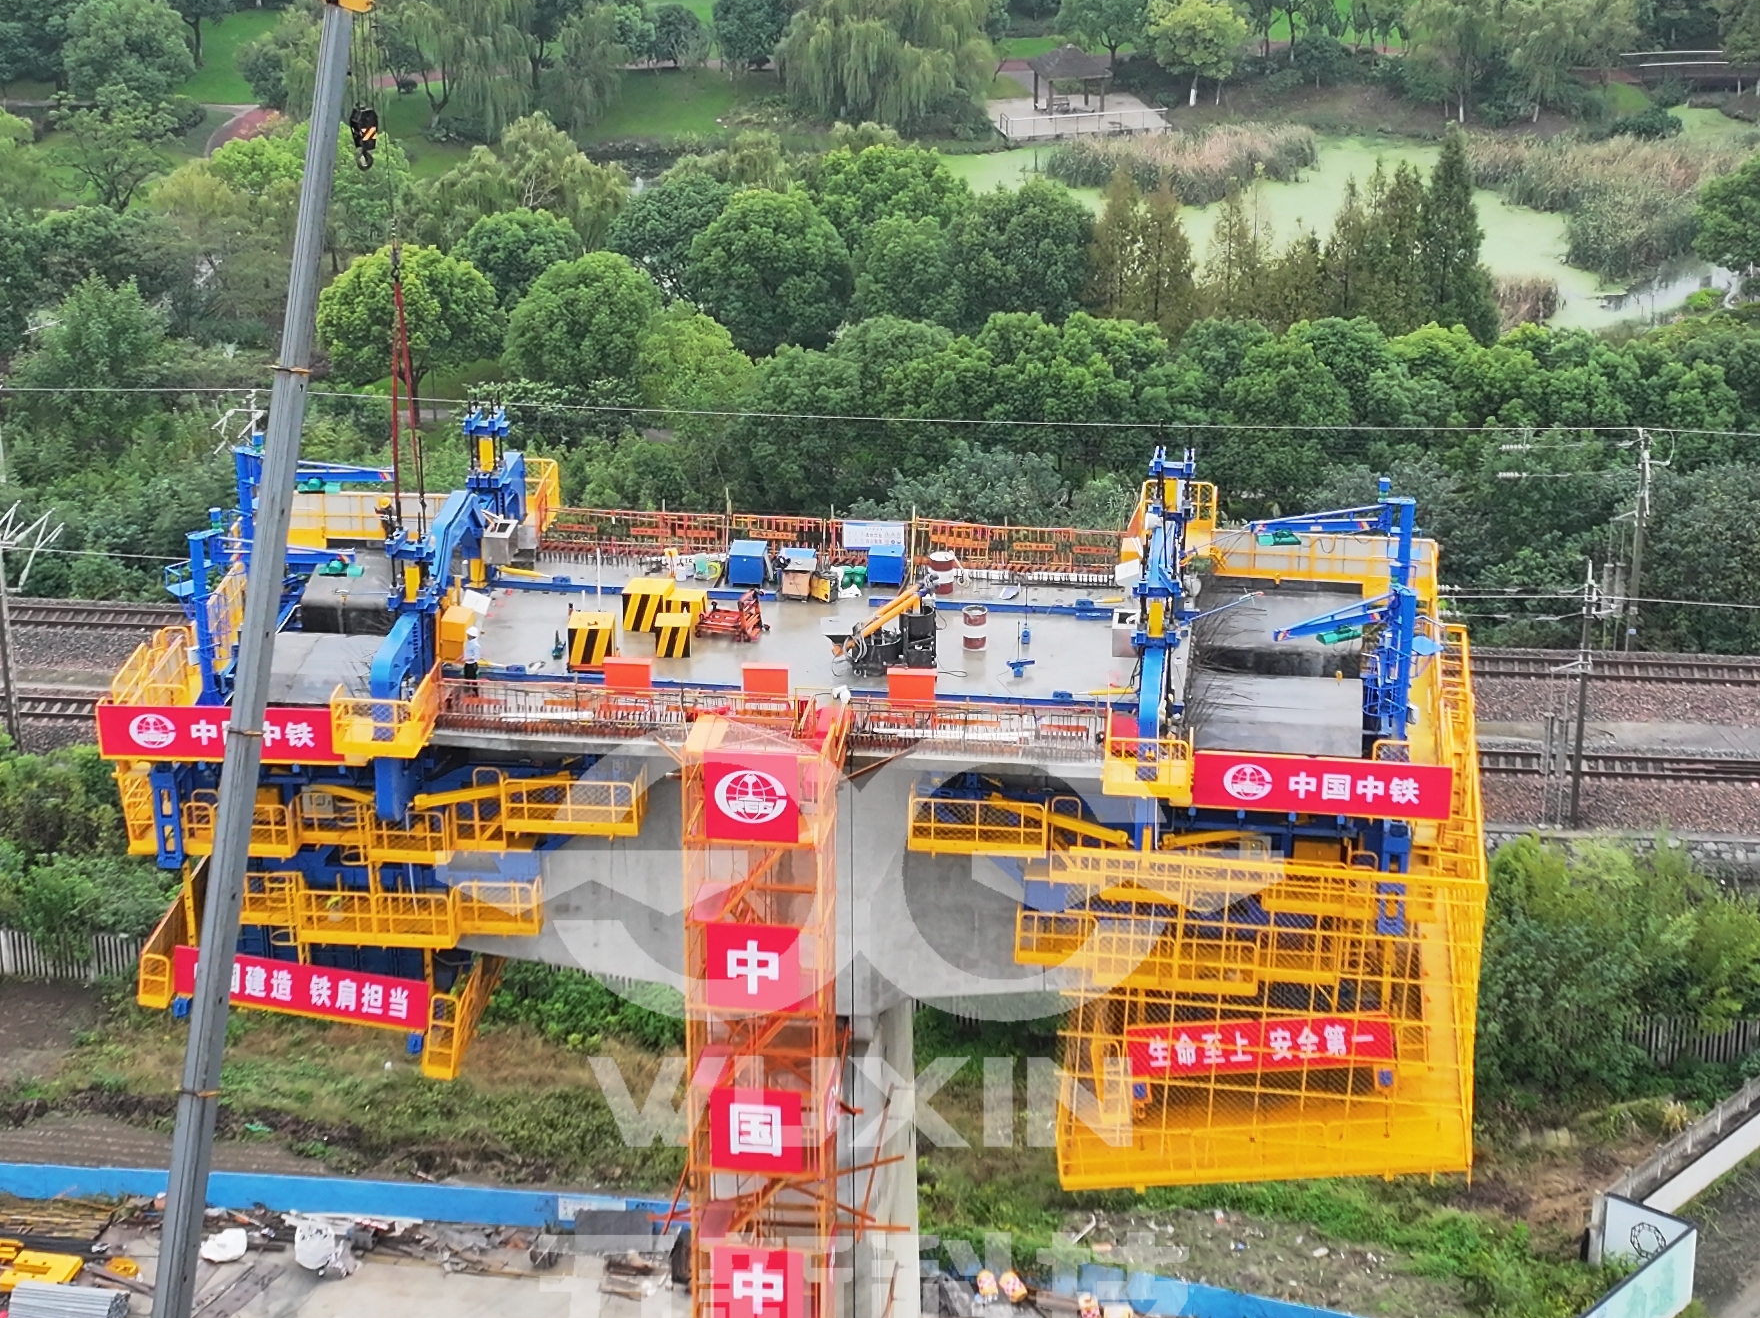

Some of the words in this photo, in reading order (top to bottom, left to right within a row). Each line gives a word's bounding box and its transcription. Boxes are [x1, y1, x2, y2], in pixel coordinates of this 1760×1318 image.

[190, 719, 316, 749] 中中铁
[1287, 771, 1420, 805] 中国中铁
[309, 973, 410, 1020] 铁肩担当
[1148, 1031, 1253, 1068] 生命至上
[1269, 1023, 1375, 1062] 安全第一
